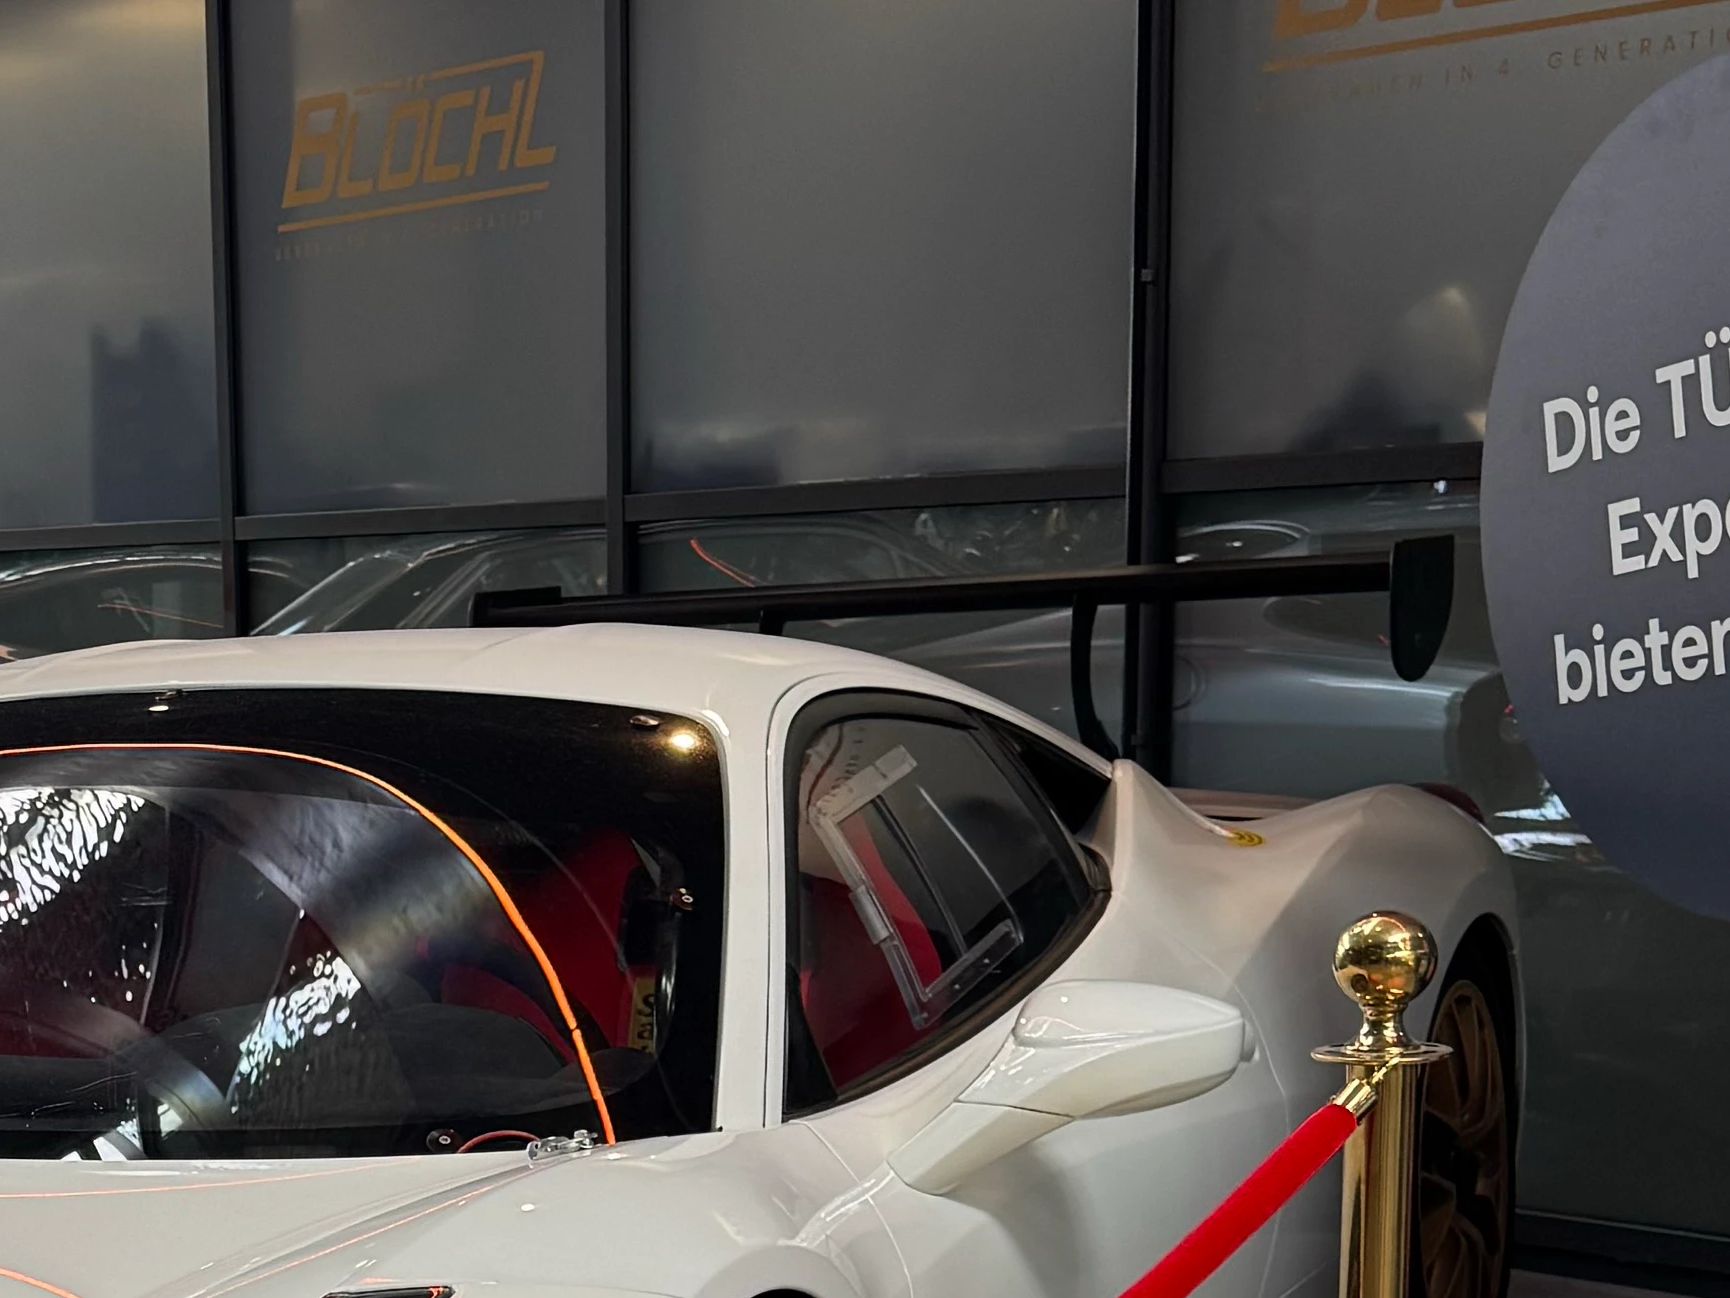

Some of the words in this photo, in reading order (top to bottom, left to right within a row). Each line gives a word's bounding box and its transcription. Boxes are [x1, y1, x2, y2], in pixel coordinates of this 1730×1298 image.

[1546, 28, 1730, 70] GENERATI
[281, 50, 557, 209] BLÖCHL
[1542, 385, 1641, 474] Die
[1607, 497, 1730, 579] Exp
